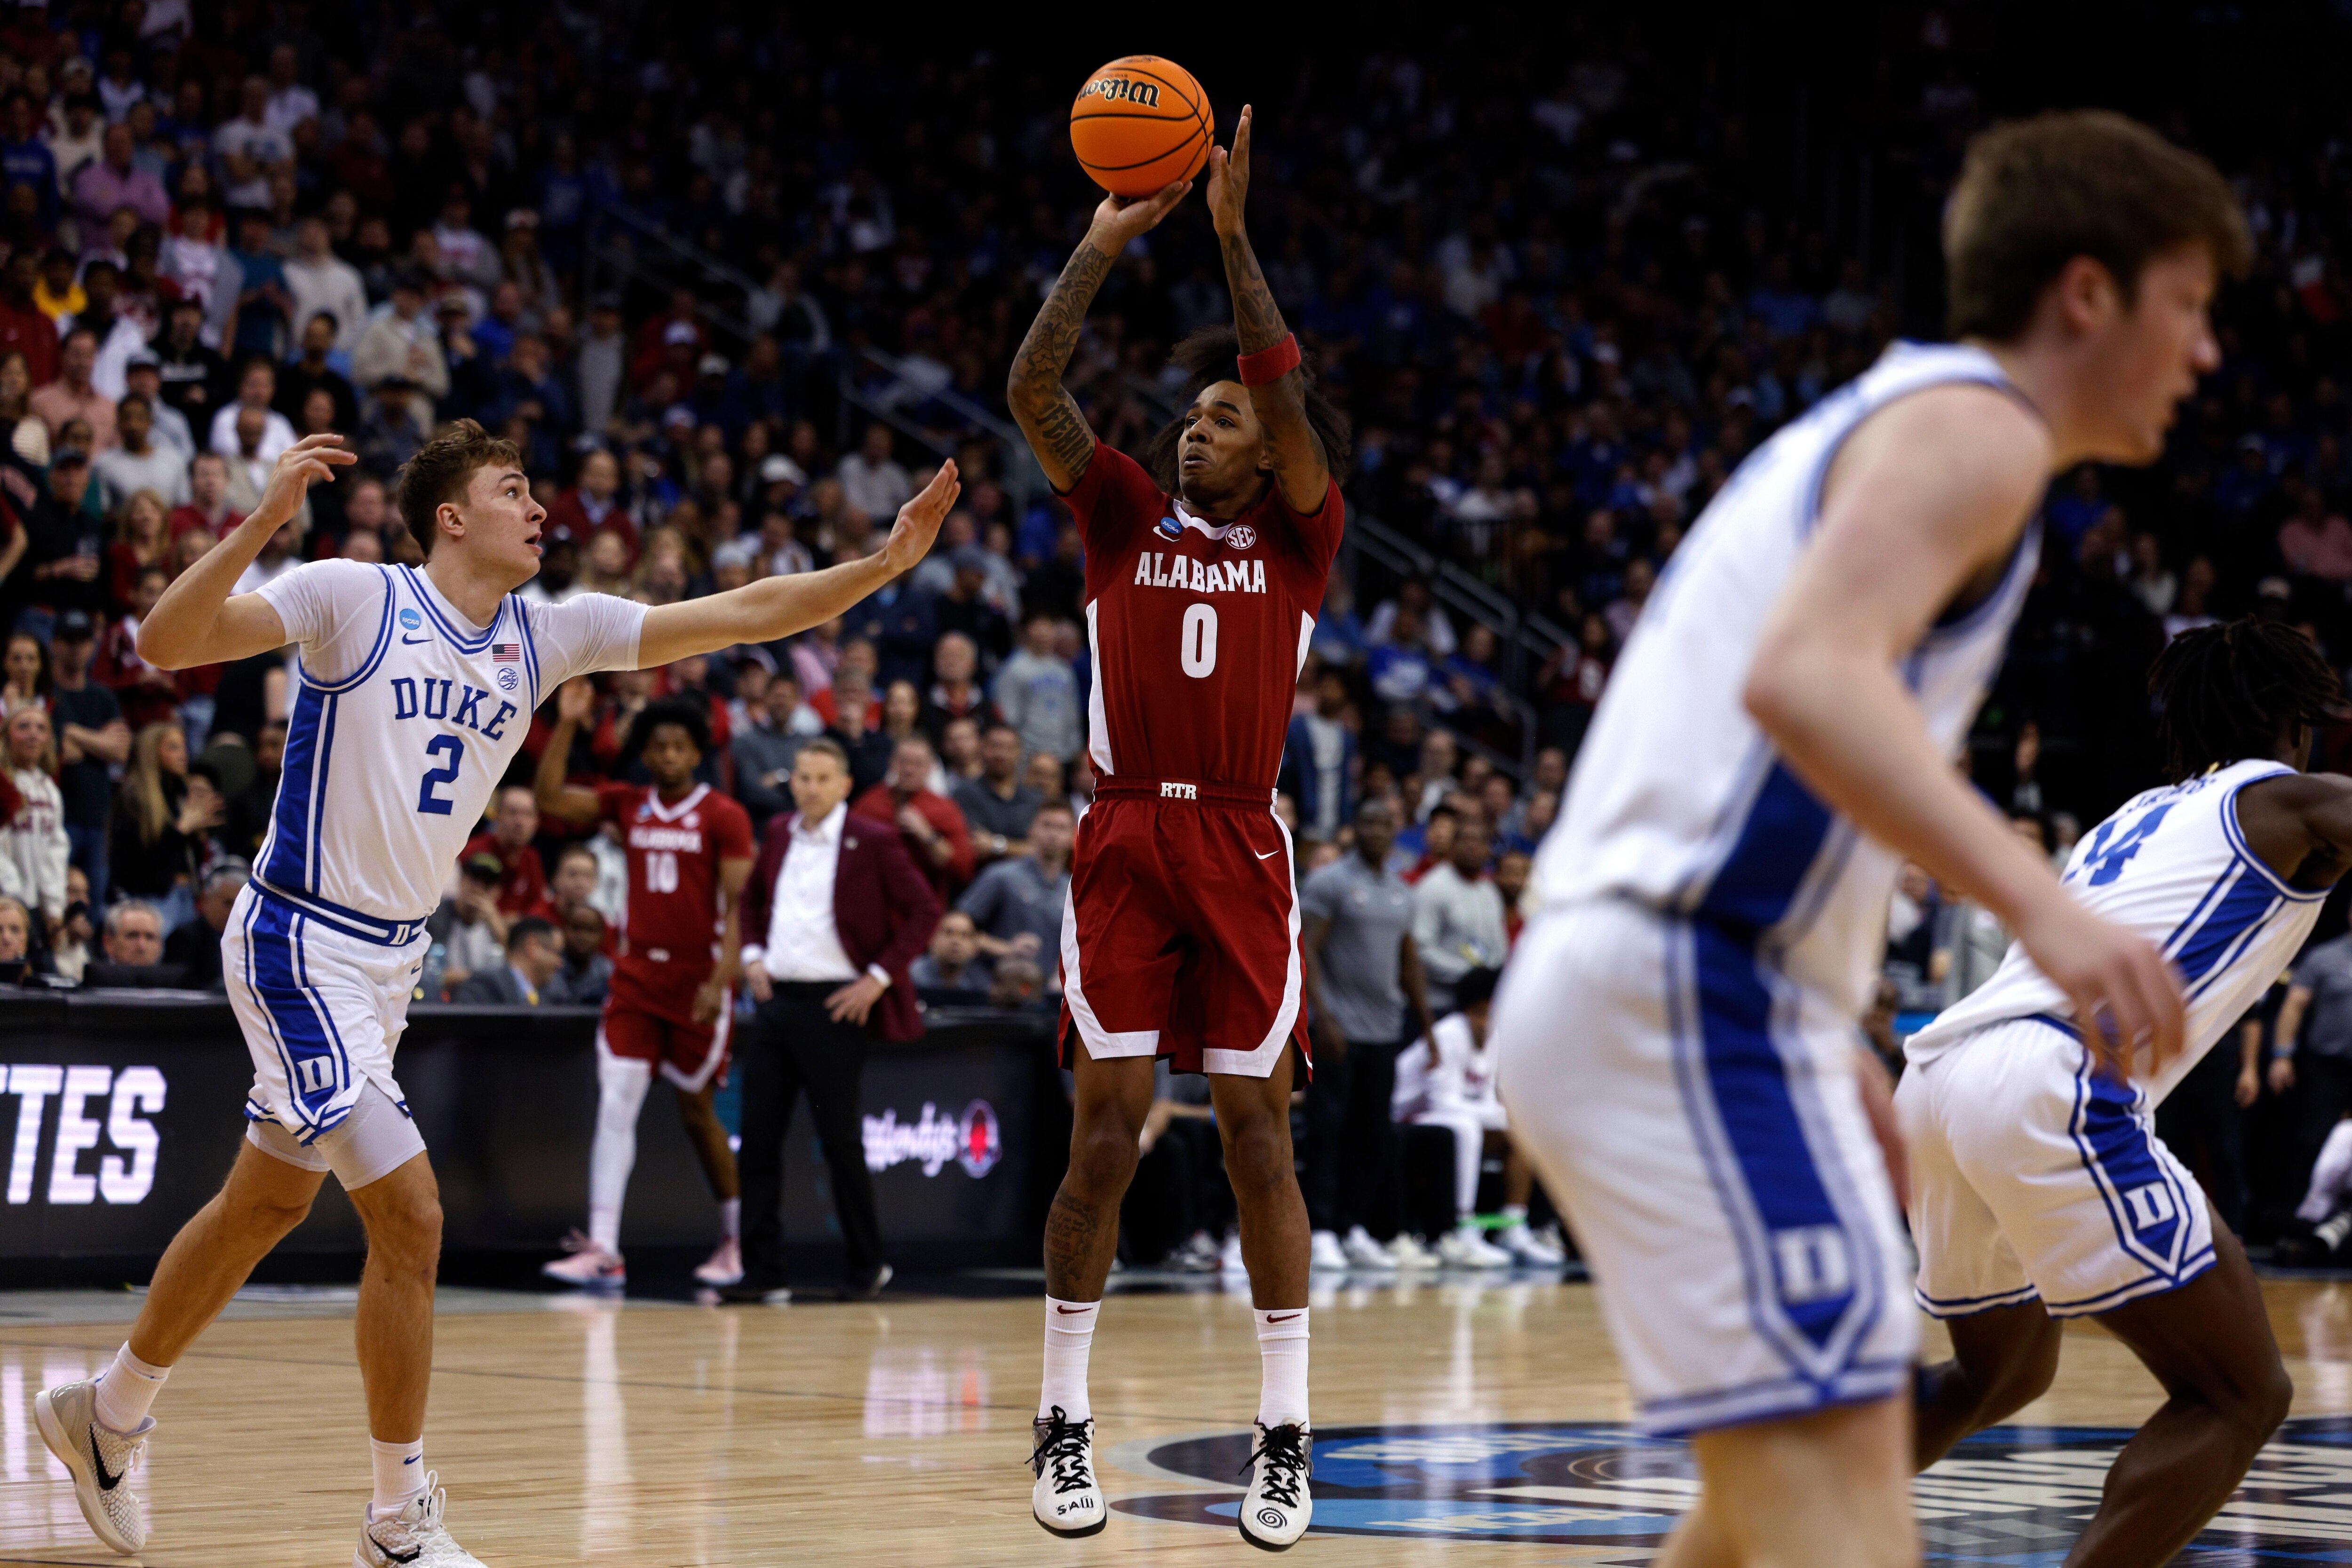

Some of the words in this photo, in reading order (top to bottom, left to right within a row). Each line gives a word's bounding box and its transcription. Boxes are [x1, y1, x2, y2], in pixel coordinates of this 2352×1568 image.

[1228, 527, 1254, 548] SEC
[1134, 552, 1266, 594] ALABAMA
[401, 616, 420, 626] NCAA
[1181, 603, 1218, 679] 0
[390, 677, 518, 741] DUKE
[417, 734, 464, 816] 2
[1160, 782, 1197, 800] RTR
[645, 851, 679, 894] 10
[297, 1055, 334, 1094] D
[0, 1063, 168, 1205] TES
[2123, 1180, 2175, 1231] D
[1366, 1508, 1663, 1532] NCAA
